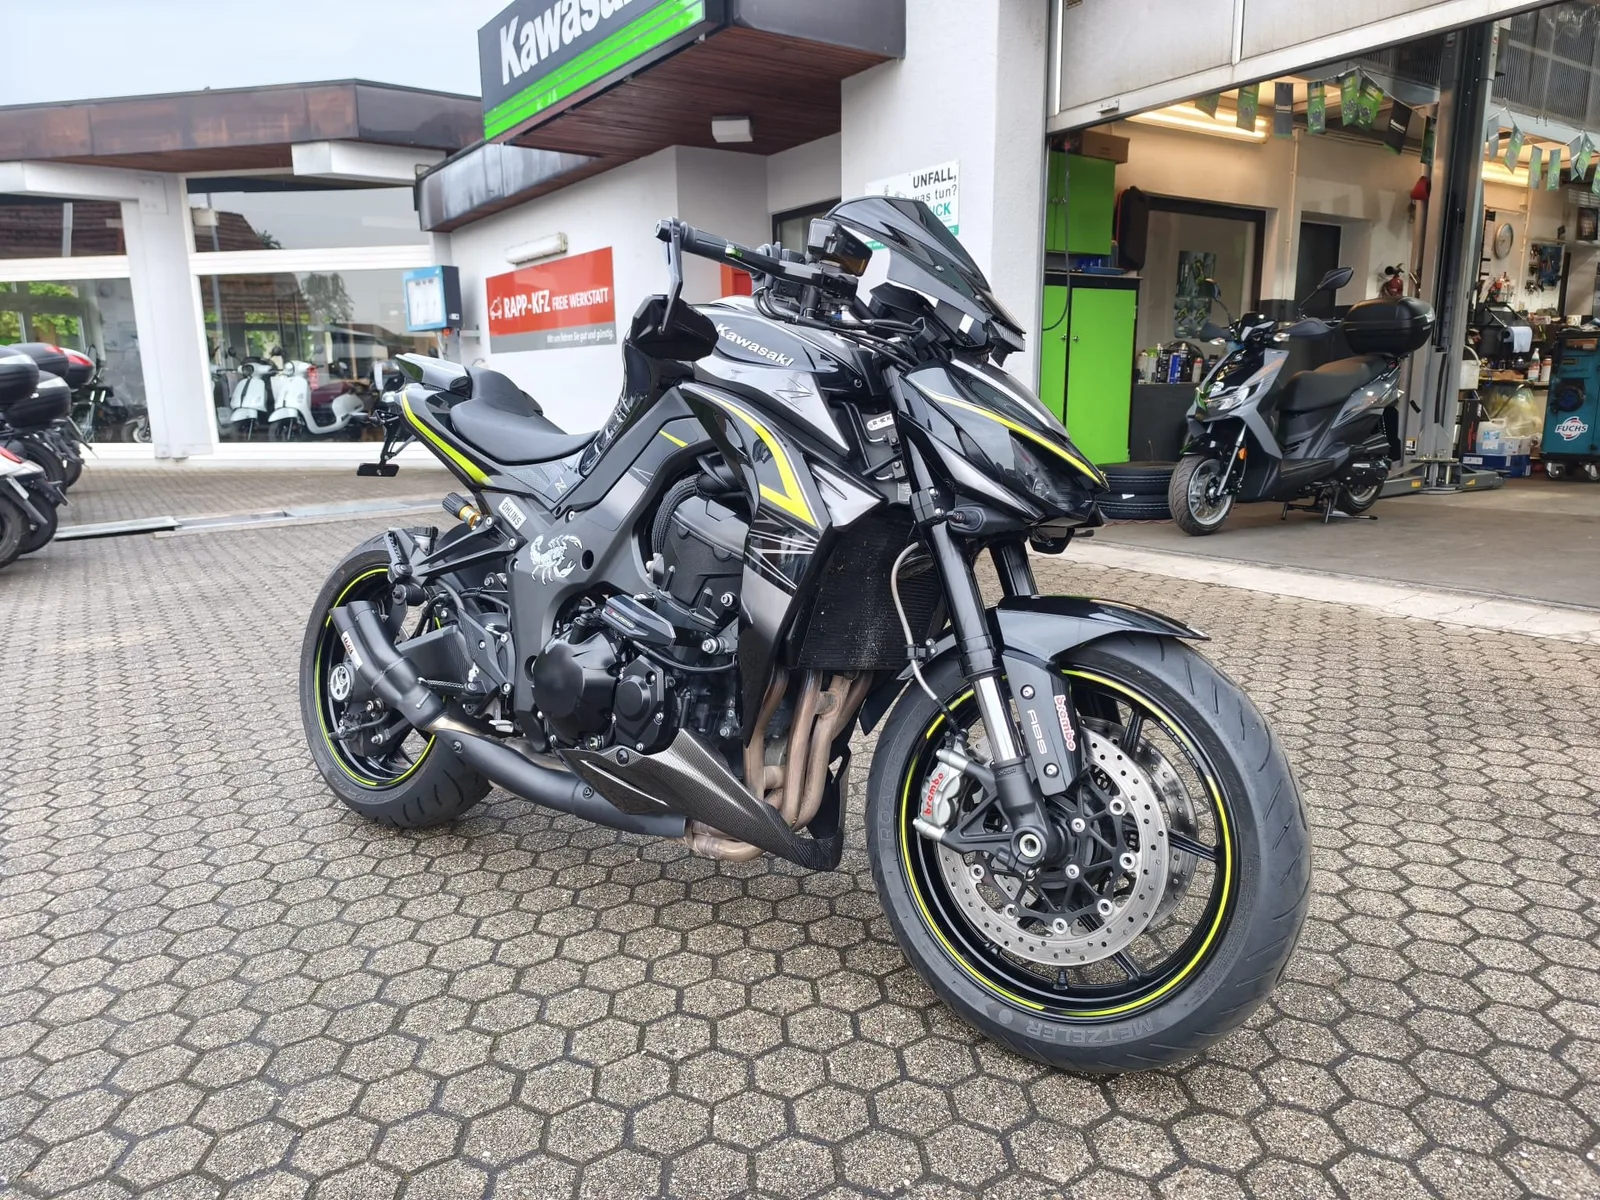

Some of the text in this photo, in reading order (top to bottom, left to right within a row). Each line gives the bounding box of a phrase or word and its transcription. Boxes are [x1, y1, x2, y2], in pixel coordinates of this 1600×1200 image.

[500, 0, 632, 86] Kawas
[913, 168, 957, 188] UNFALL,
[935, 184, 957, 200] tun?
[504, 288, 608, 318] RAPP-KFZ FREIE WERKSTATT
[716, 323, 795, 367] Kawasaki
[1028, 709, 1047, 754] ABS
[1054, 695, 1076, 751] brembo
[924, 772, 945, 816] brembo
[1026, 1017, 1154, 1044] METZELER
